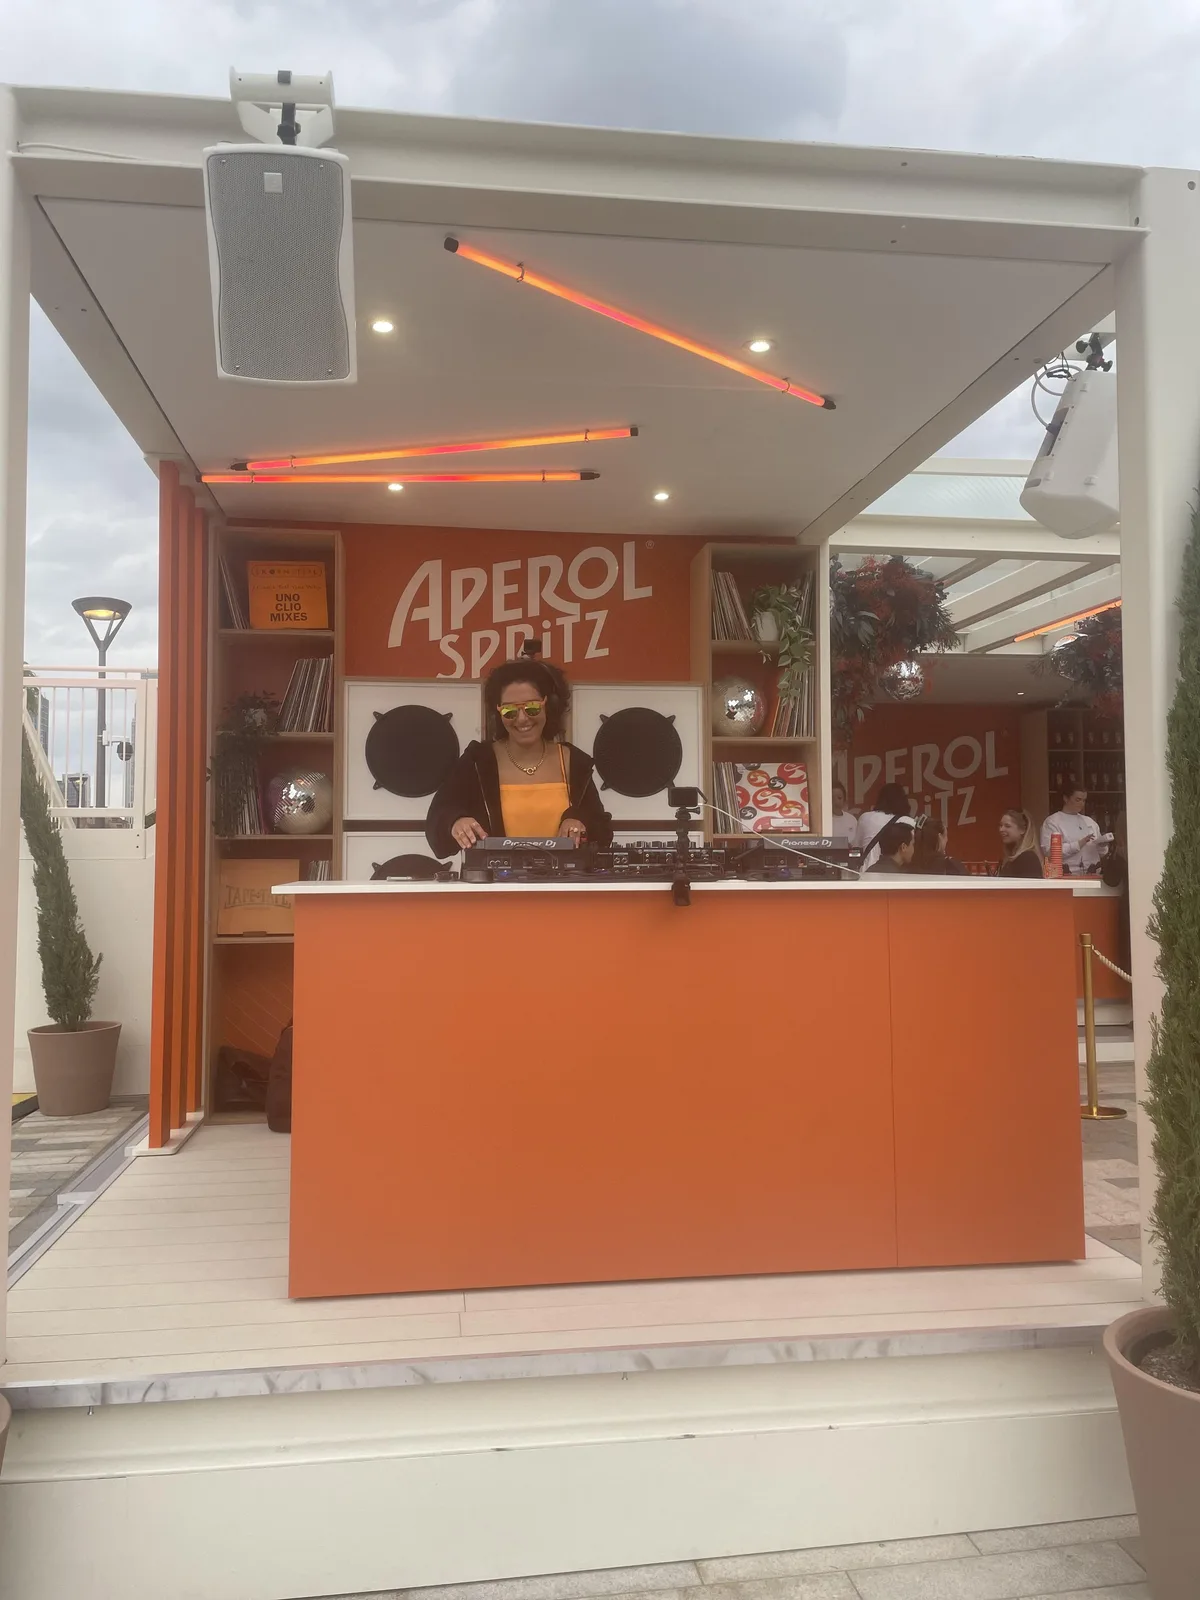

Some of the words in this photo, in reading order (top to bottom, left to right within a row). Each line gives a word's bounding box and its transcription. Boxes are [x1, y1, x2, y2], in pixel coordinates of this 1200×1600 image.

[275, 593, 300, 602] UNO
[388, 541, 652, 648] APEROL
[275, 602, 302, 612] CLIO
[270, 612, 308, 622] MIXES
